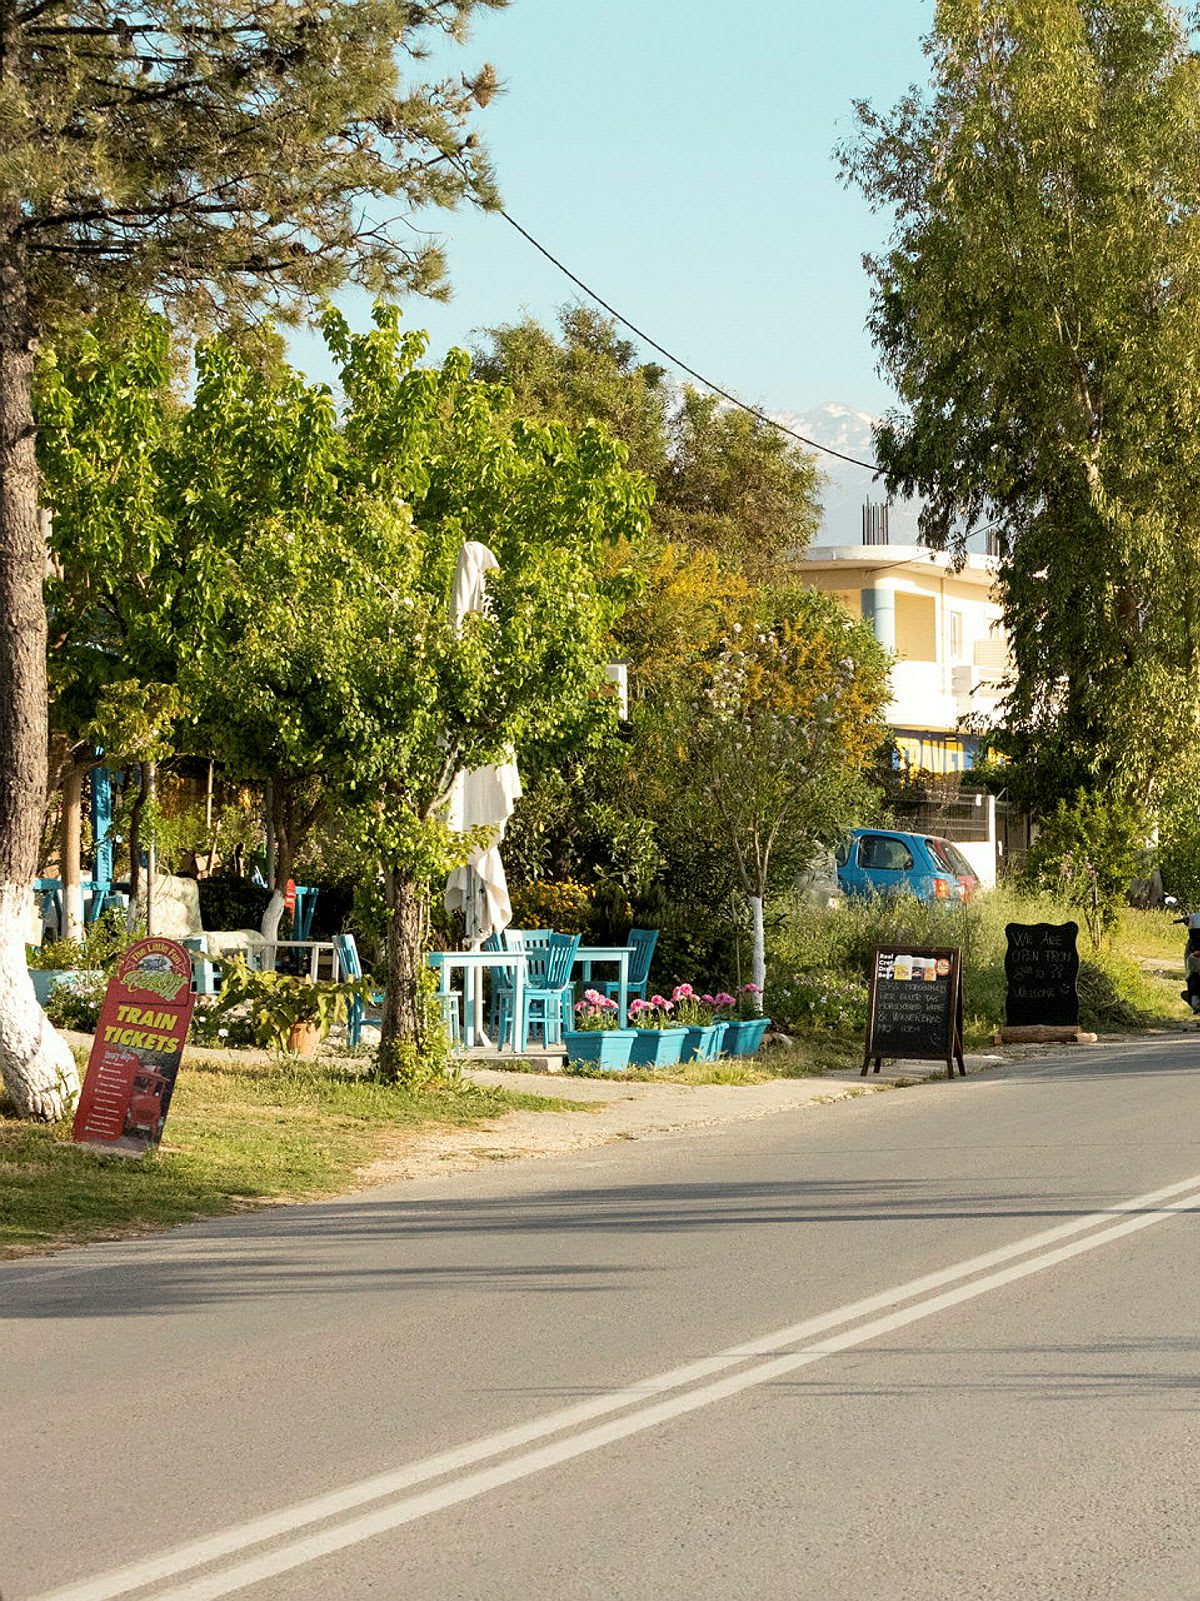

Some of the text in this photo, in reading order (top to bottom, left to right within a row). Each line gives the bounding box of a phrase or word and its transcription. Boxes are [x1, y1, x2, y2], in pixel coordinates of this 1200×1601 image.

[131, 943, 182, 965] The Little Fun
[116, 1005, 178, 1032] TRAIN
[103, 1025, 180, 1054] TICKETS
